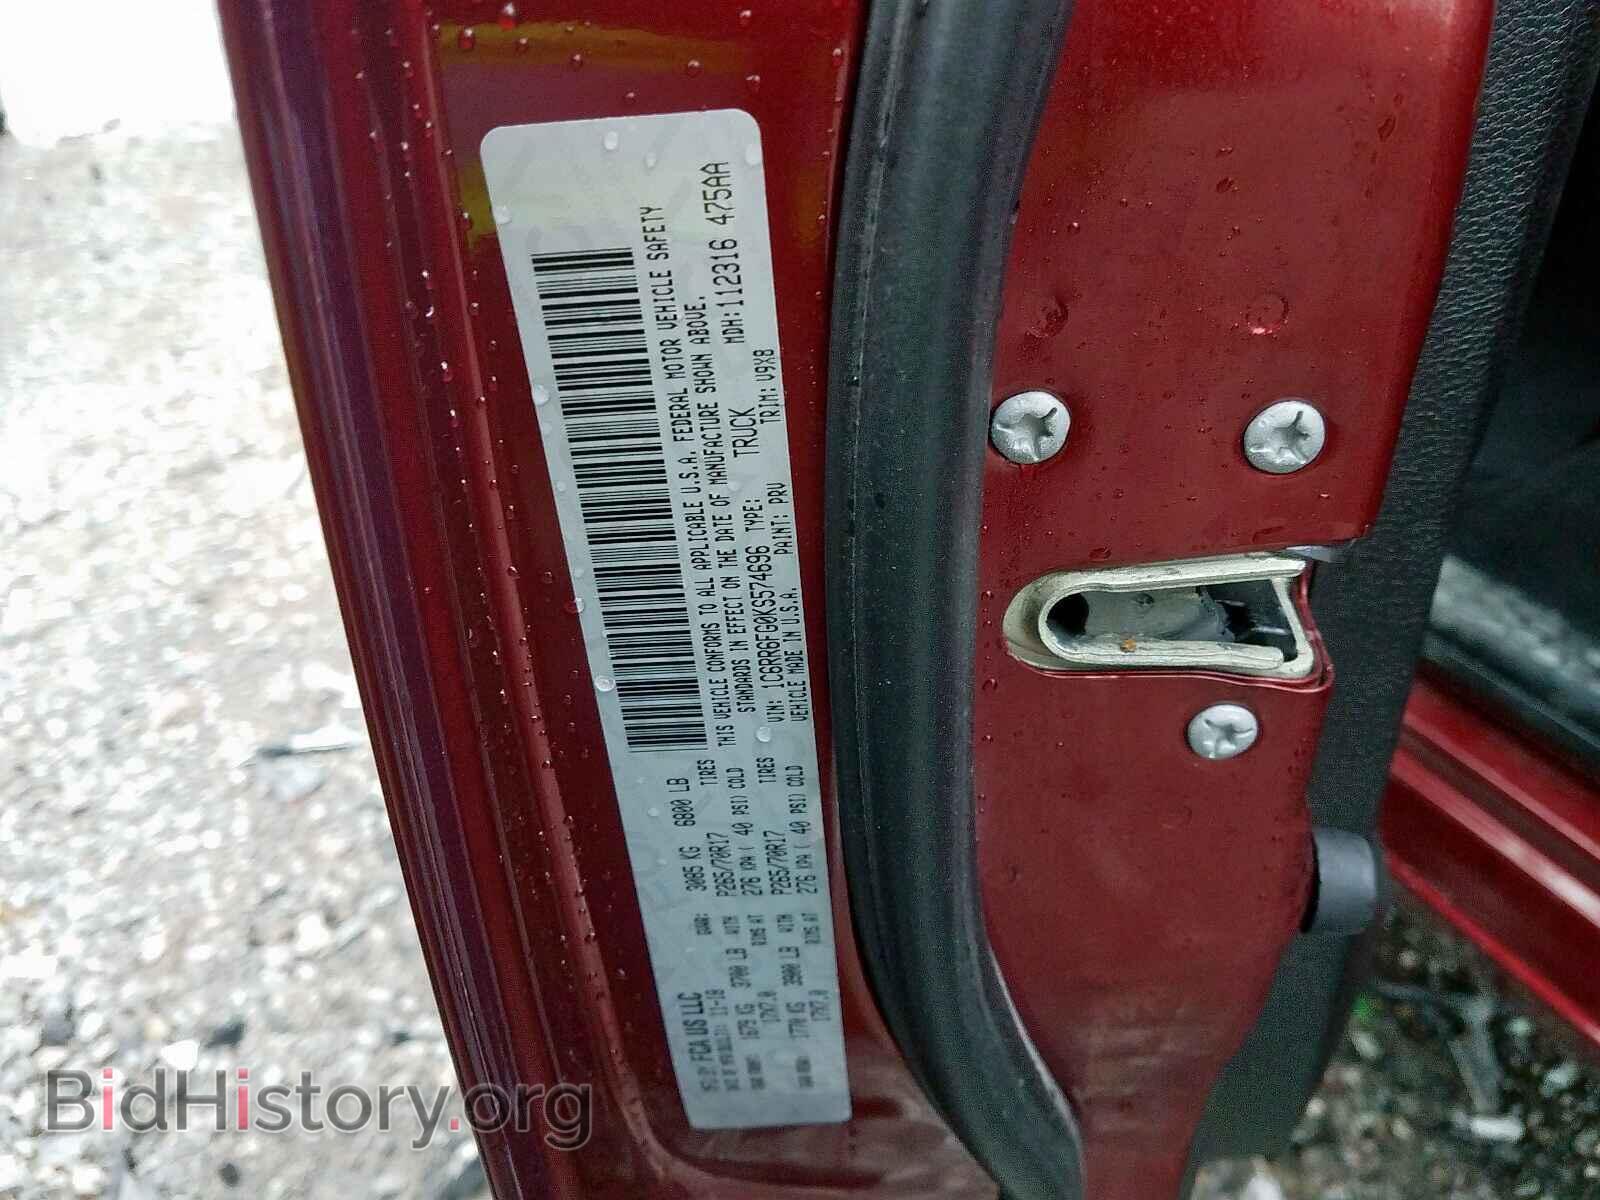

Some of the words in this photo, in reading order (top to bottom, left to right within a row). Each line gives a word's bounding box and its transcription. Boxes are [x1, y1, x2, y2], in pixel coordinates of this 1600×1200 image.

[699, 161, 735, 227] 475AA
[638, 203, 671, 261] SAFETY
[648, 269, 680, 330] VEHICLE
[682, 295, 712, 345] ABOVE.
[657, 337, 687, 380] MOTOR
[752, 348, 778, 382] V9X8
[690, 352, 717, 393] SHOWN
[665, 387, 695, 442] FEDERAL
[756, 386, 781, 424] TRIM:
[696, 401, 729, 486] MANUFACTURE
[727, 406, 760, 457] TRUCK
[674, 449, 702, 494] U.S.A.
[708, 491, 731, 507] OF
[766, 481, 789, 504] PRV
[711, 513, 735, 542] DATE
[741, 497, 765, 532] TYPE:
[681, 500, 713, 571] APPLICABLE
[770, 513, 794, 555] PAINT:
[715, 548, 739, 568] THE
[692, 576, 716, 597] ALL
[719, 574, 741, 589] ON
[696, 602, 719, 615] TO
[722, 594, 747, 634] EFFECT
[744, 544, 785, 690] 1C6RR6FG0KS574696
[777, 587, 801, 625] U.S.A.
[699, 621, 727, 672] CONFORMS
[727, 639, 749, 651] IN
[781, 630, 802, 642] IN
[783, 649, 805, 674] MADE
[707, 677, 733, 720] VEHICLE
[730, 658, 756, 713] STANDARDS
[764, 699, 785, 723] VIN:
[787, 680, 809, 721] VEHICLE
[714, 723, 737, 747] THIS
[696, 758, 718, 785] TIRES
[725, 766, 746, 789] COLD
[755, 756, 777, 783] TIRES
[784, 764, 805, 787] COLD
[665, 776, 690, 792] LB
[669, 798, 696, 827] 6800
[729, 794, 750, 816] PSI)
[787, 792, 807, 814] PSI)
[731, 821, 754, 836] 40
[788, 820, 811, 835] 40
[678, 845, 702, 860] KG
[705, 830, 737, 897] P265/70R17
[763, 829, 792, 895] P265/70R17
[681, 864, 707, 892] 3085
[739, 875, 763, 896] 276
[794, 873, 817, 894] 276
[724, 947, 747, 960] LB
[777, 945, 800, 959] LB
[676, 991, 705, 1015] LLC
[681, 1018, 708, 1036] US
[686, 1039, 713, 1062] FCA
